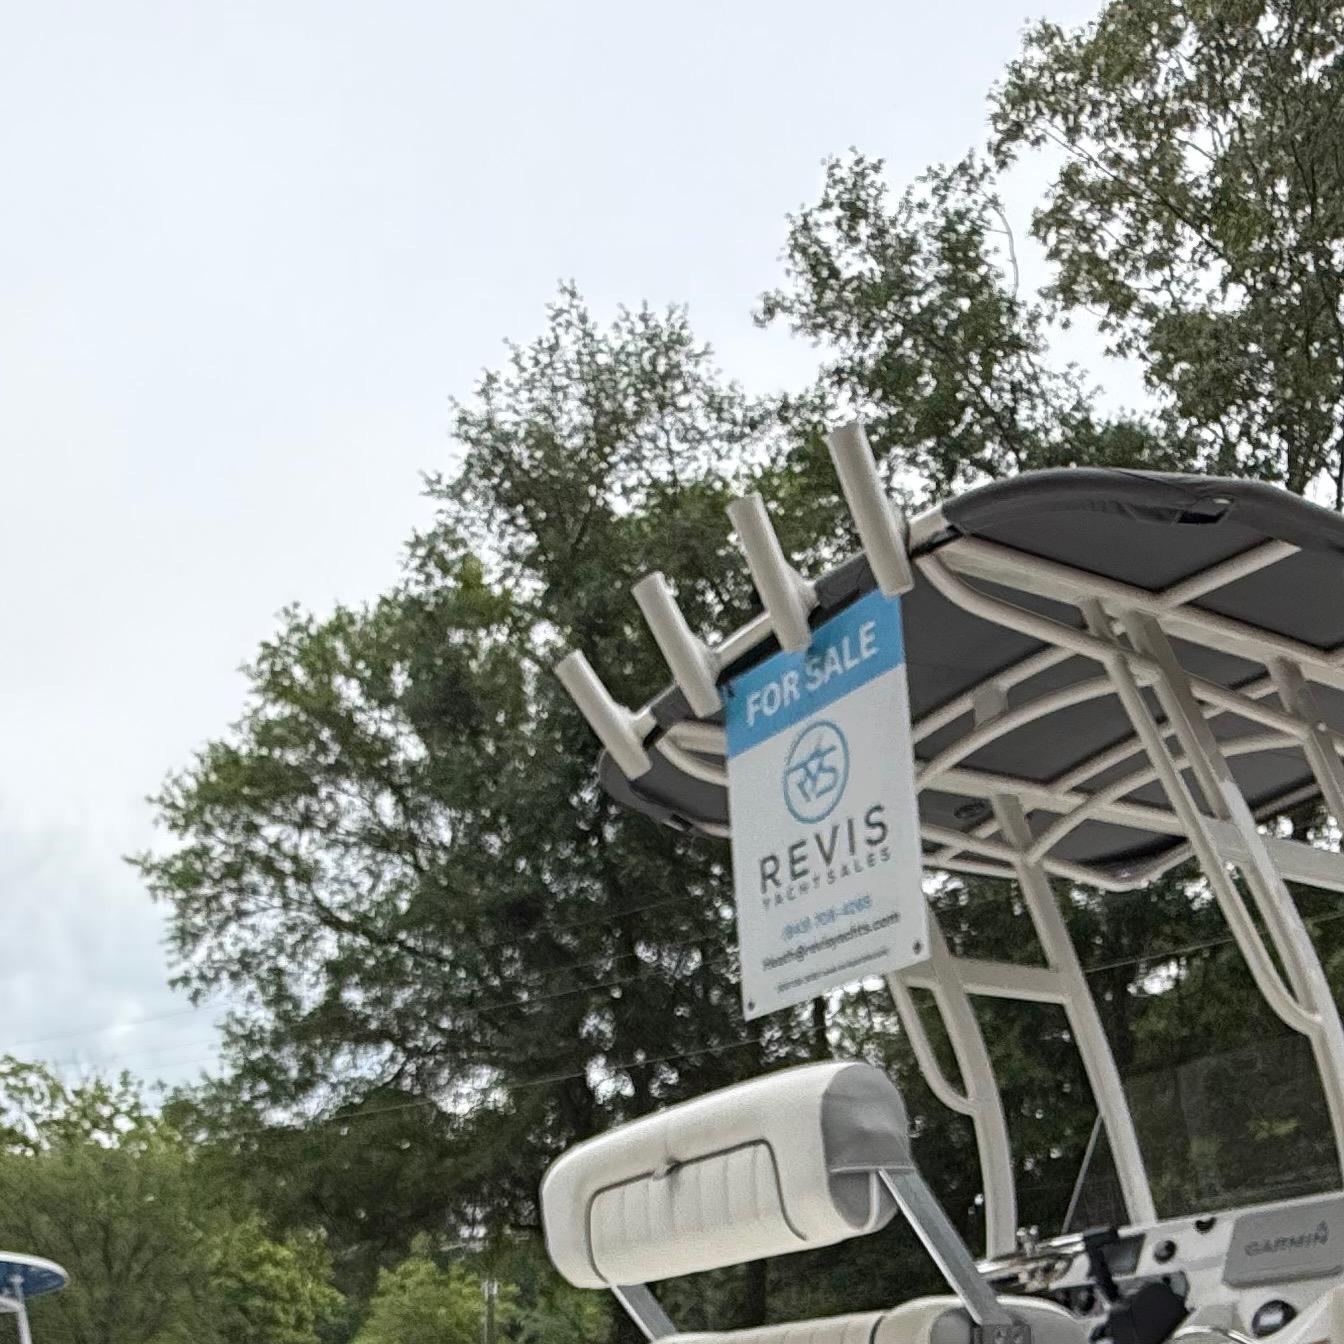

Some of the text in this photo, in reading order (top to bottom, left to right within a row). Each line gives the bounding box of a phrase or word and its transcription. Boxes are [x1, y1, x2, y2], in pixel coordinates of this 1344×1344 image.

[746, 620, 879, 727] FOR SALE
[760, 803, 888, 895] REVIS
[1244, 1229, 1329, 1257] GARMIN
